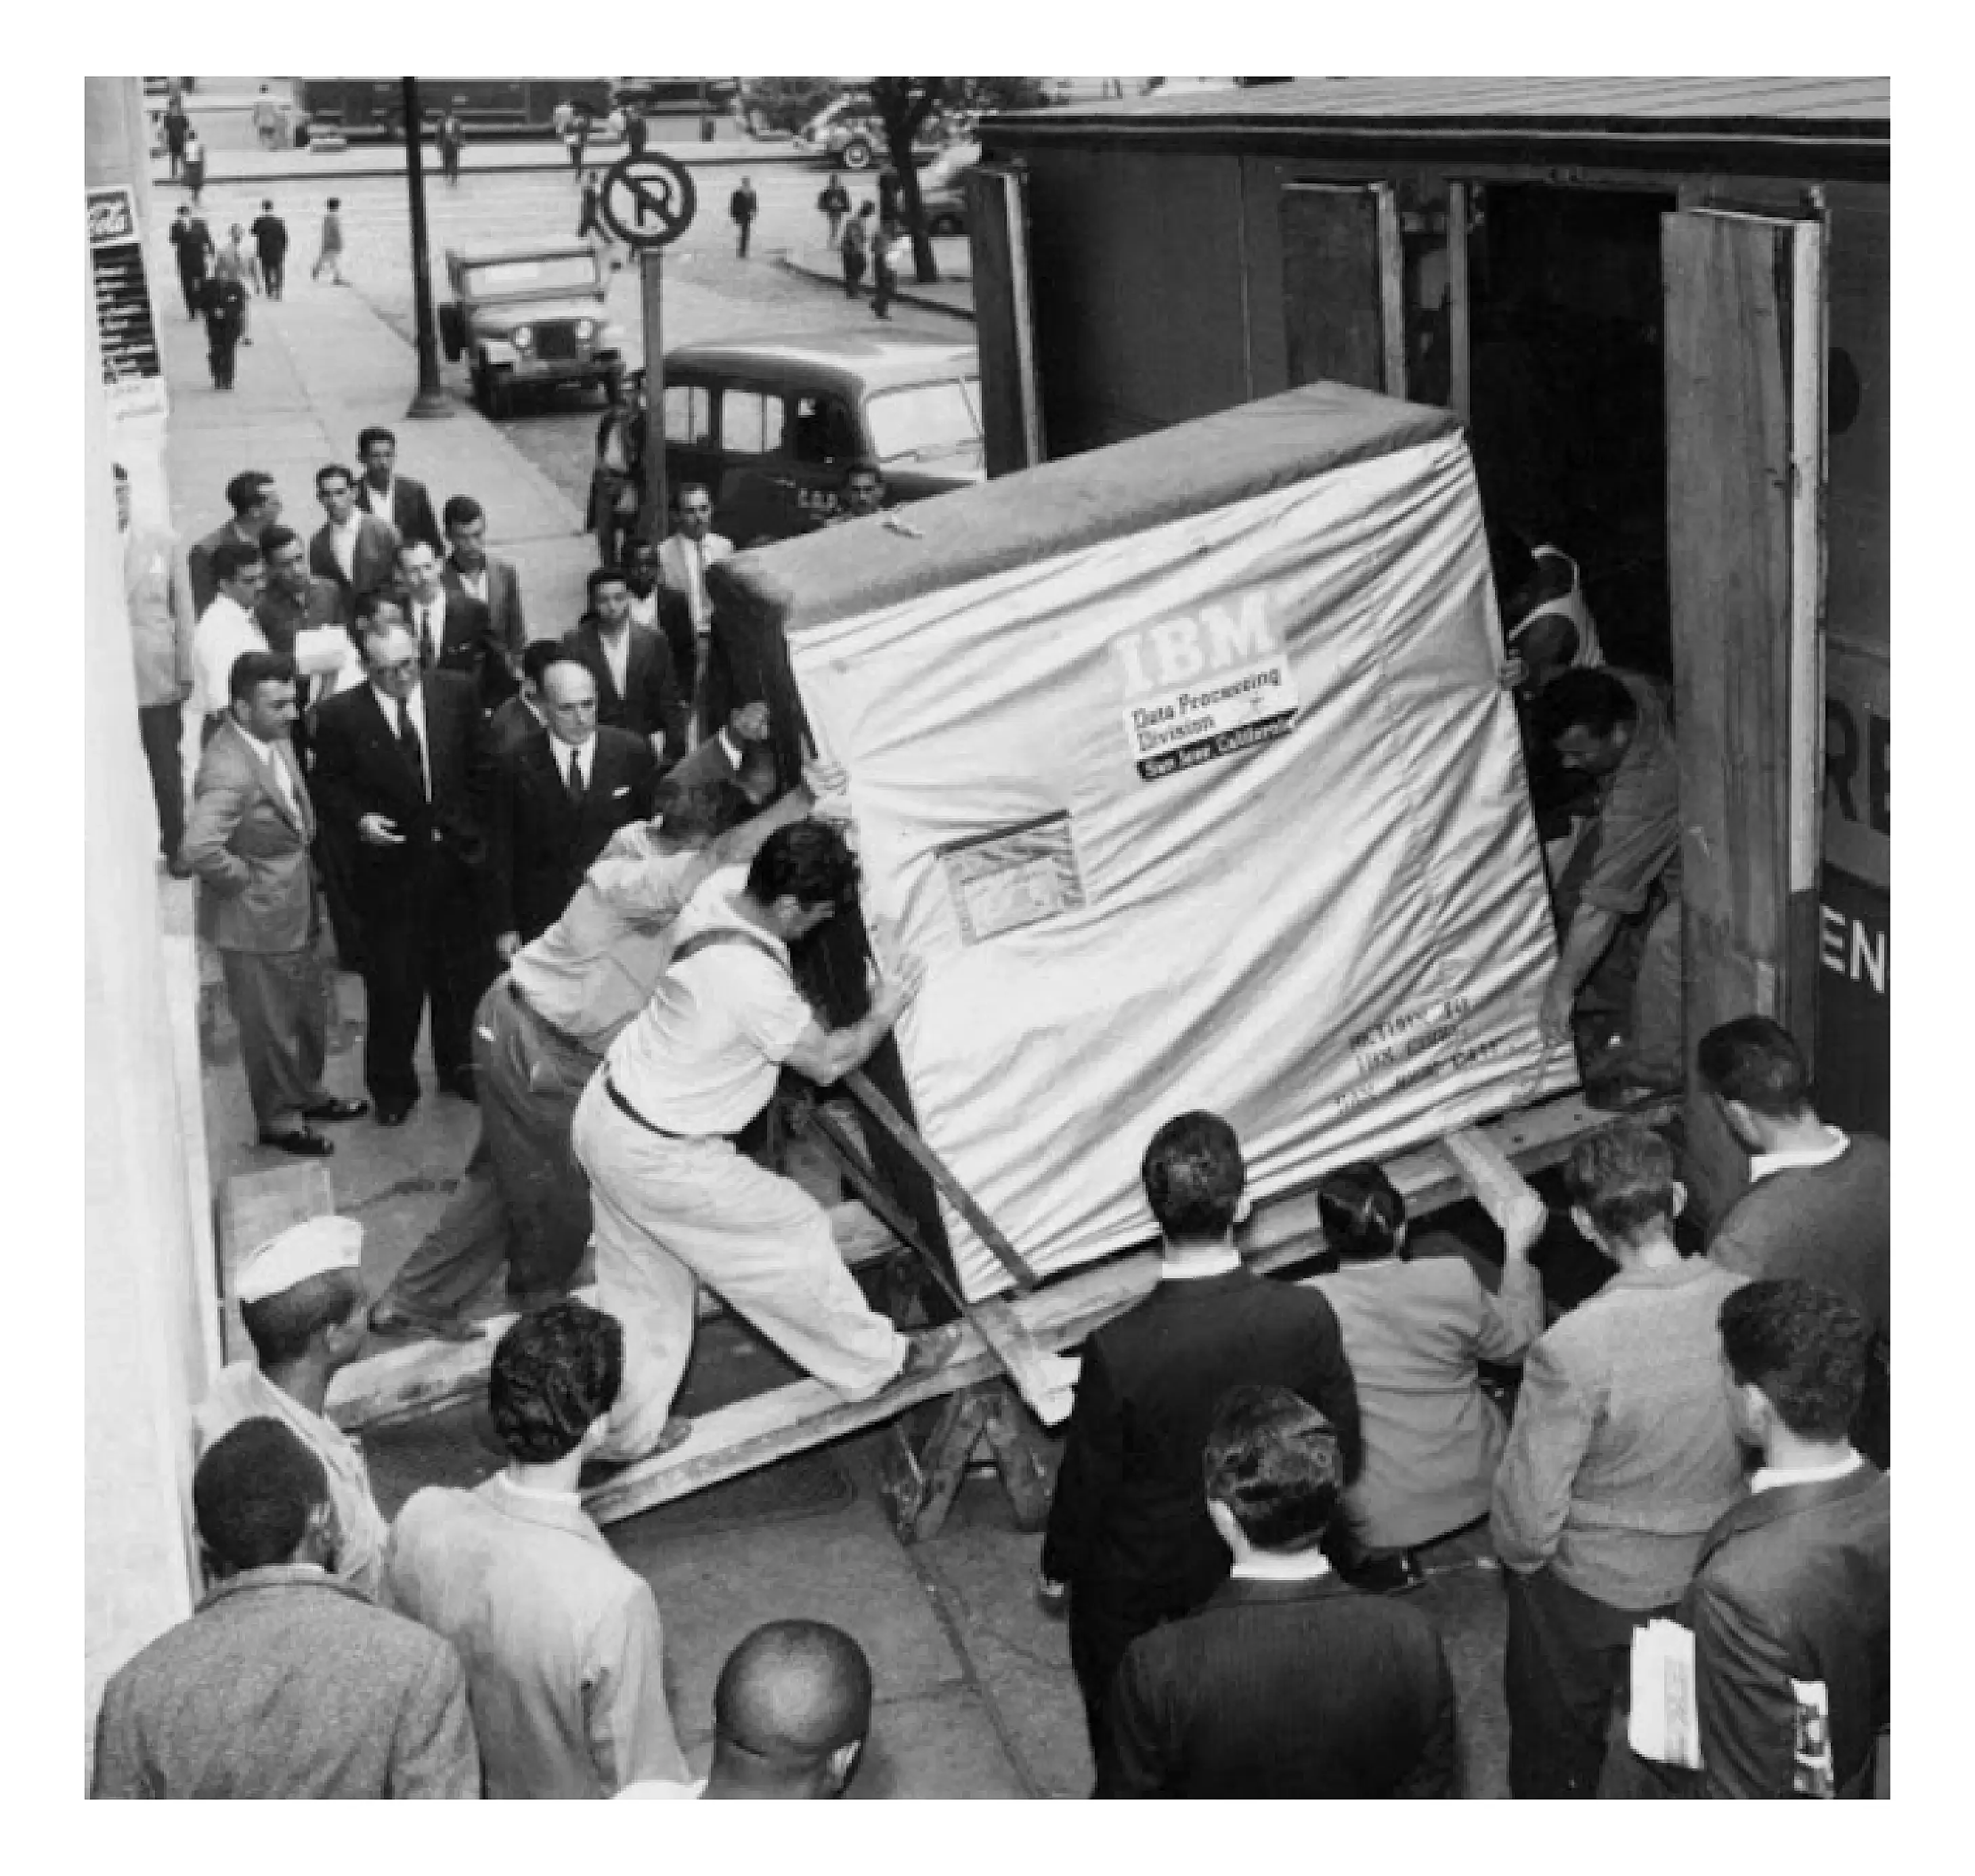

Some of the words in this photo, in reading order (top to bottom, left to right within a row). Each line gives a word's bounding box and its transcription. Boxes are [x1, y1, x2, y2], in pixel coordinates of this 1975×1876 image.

[634, 175, 671, 227] P
[1114, 590, 1276, 698] IBM
[1131, 703, 1176, 729] Data
[1177, 667, 1282, 716] Processing
[1137, 714, 1216, 753] Division
